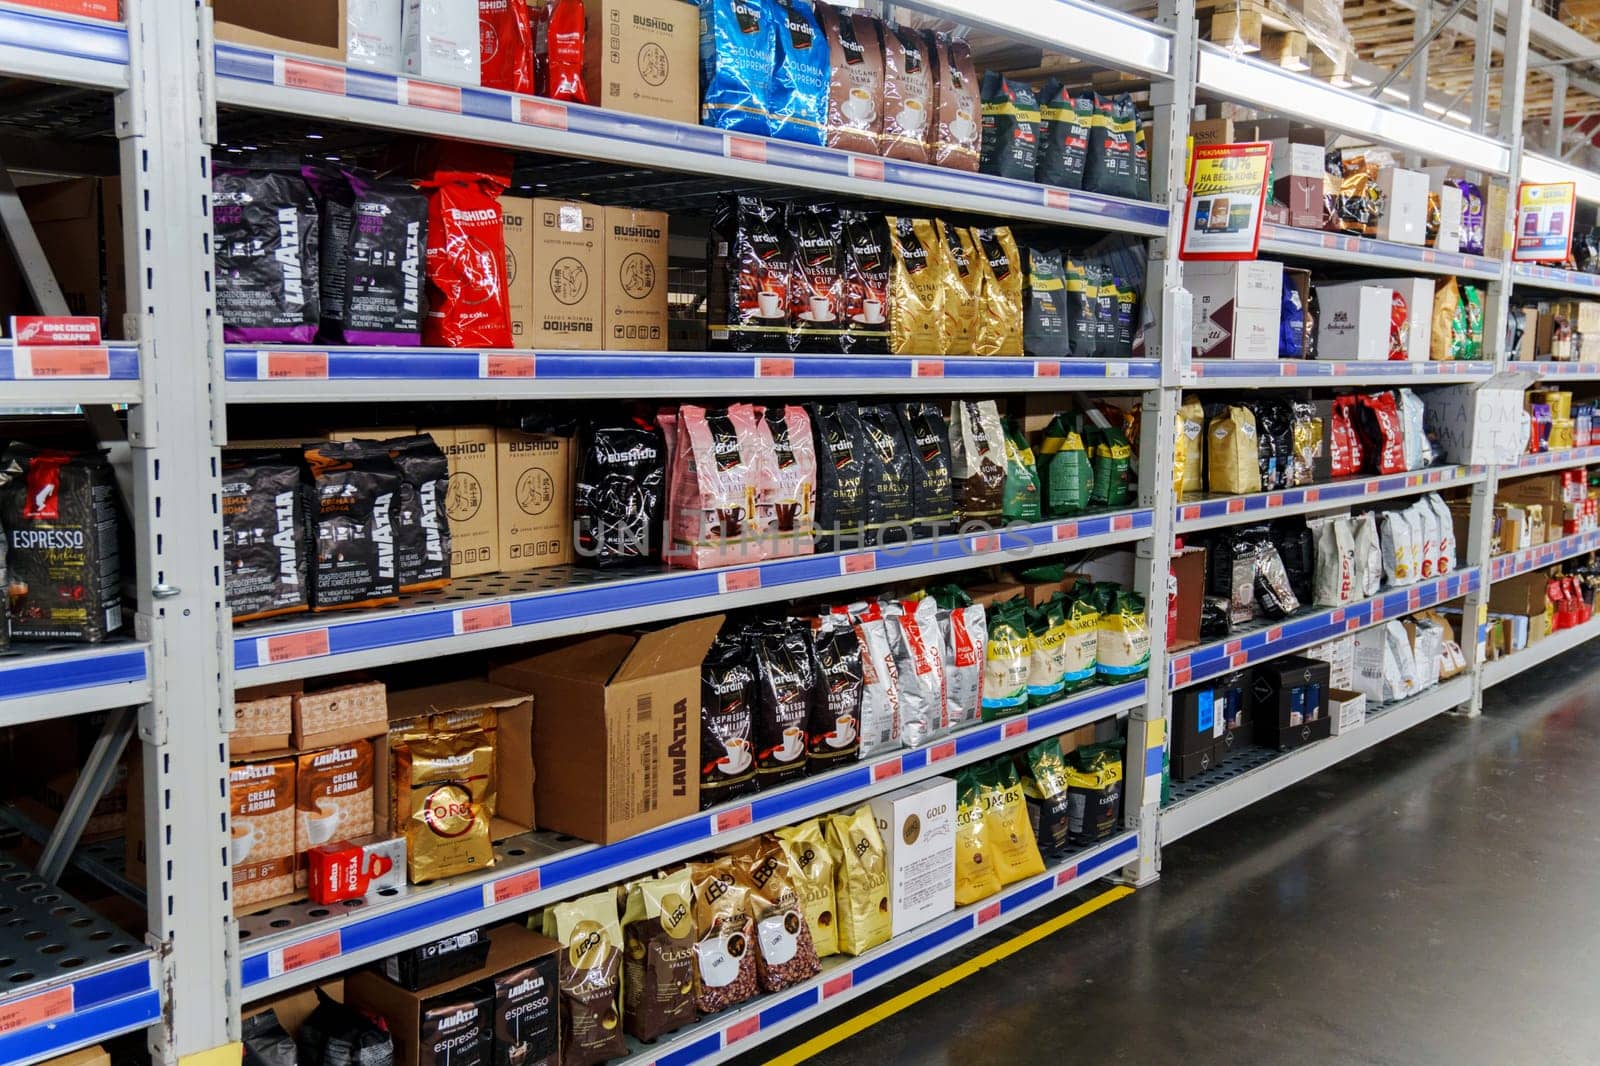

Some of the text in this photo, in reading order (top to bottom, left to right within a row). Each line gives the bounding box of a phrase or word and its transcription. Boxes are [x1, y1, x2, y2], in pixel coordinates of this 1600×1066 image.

[633, 14, 674, 33] BUSHIDO
[784, 18, 815, 36] Jardin
[451, 208, 497, 221] BUSHIDO
[614, 225, 661, 239] BUSHIDO
[275, 207, 305, 305] LAVAZZA
[401, 221, 420, 313] LAVAZZA
[814, 276, 832, 285] CUP
[543, 320, 593, 332] BUSHIDO
[509, 440, 559, 452] BUSHIDO
[420, 480, 443, 561] LAVAZZA
[13, 530, 83, 549] ESPRESSO
[272, 490, 299, 585] LAVAZZA
[372, 492, 394, 578] LAVAZZA
[713, 681, 744, 696] Jardin
[667, 697, 688, 796] LAVAZZA
[314, 748, 358, 767] LAVAZZA
[332, 771, 358, 784] CREMA
[248, 789, 276, 803] CREMA
[326, 780, 358, 795] E AROMA
[240, 799, 276, 814] E AROMA
[926, 804, 947, 819] GOLD
[348, 855, 358, 892] ROSSA
[752, 855, 779, 890] LEBO
[704, 873, 736, 906] LEBO
[668, 903, 687, 929] LEBO
[575, 931, 601, 958] LEBO
[508, 976, 545, 999] LAVAZZA
[504, 996, 549, 1021] espresso
[523, 1008, 549, 1023] ITALIANO
[438, 1007, 479, 1031] LAVAZZA
[434, 1026, 480, 1053] espresso
